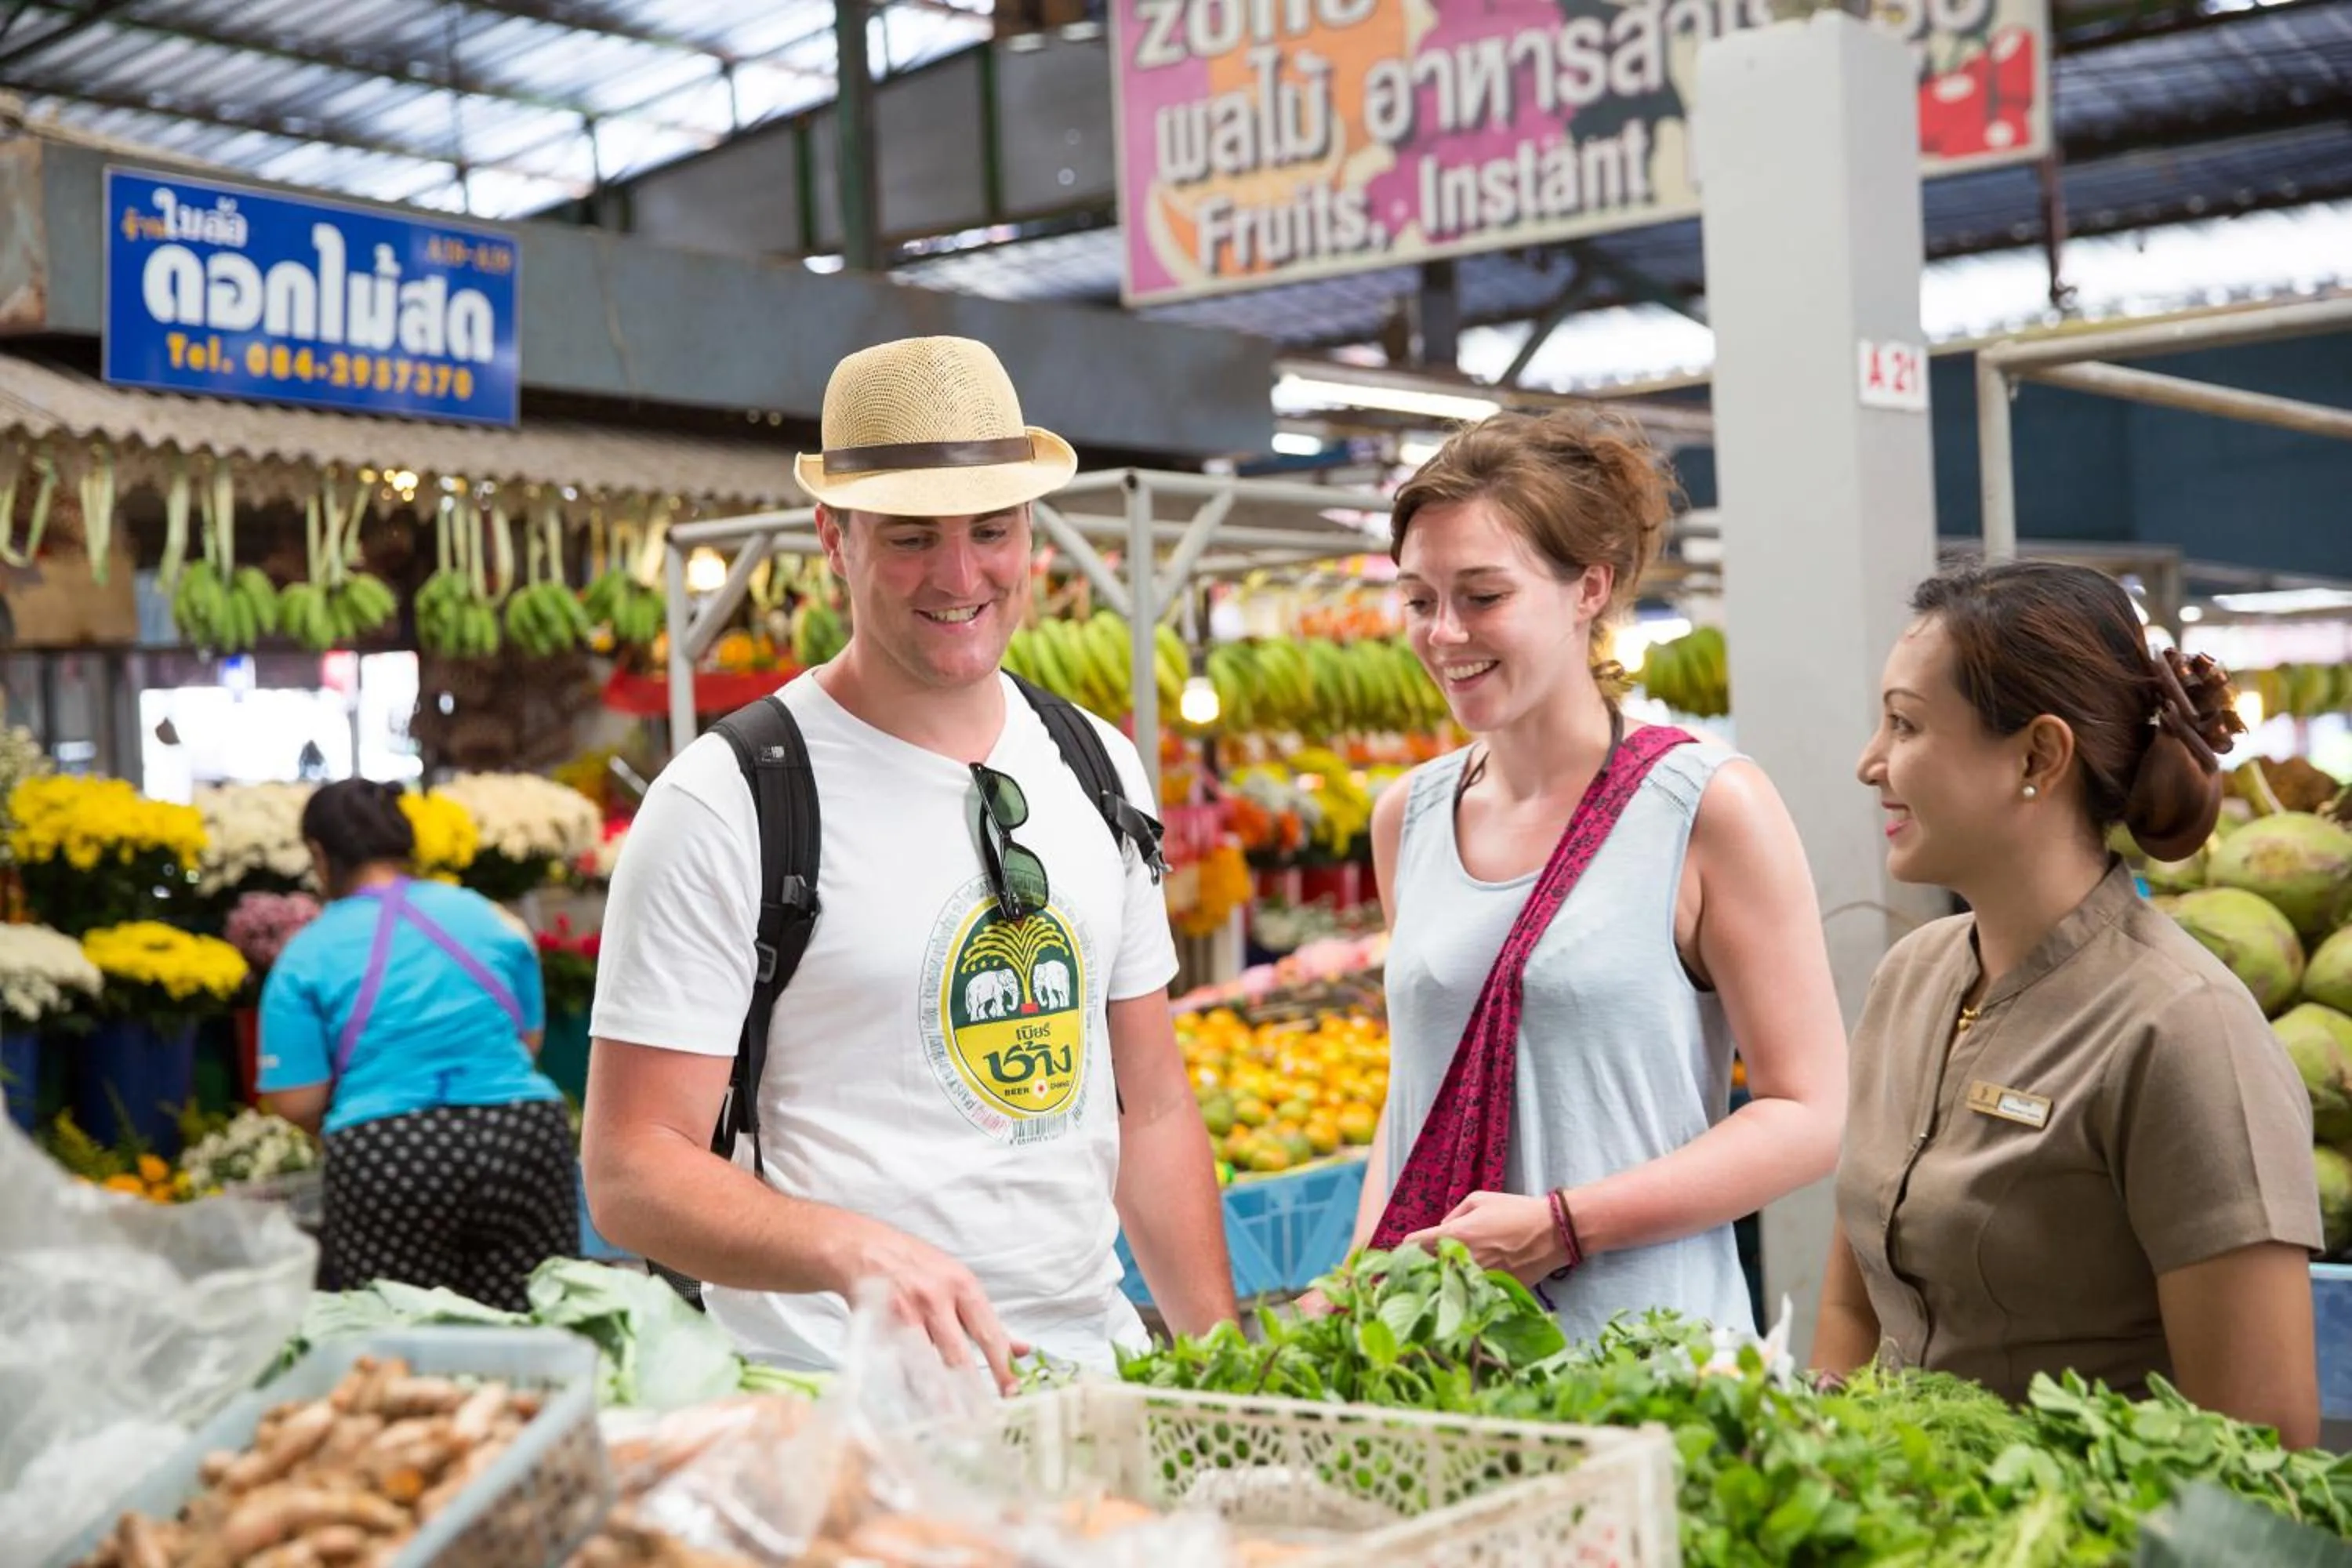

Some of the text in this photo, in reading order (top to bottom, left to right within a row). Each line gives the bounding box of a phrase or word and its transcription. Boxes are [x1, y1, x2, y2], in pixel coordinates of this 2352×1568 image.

[1420, 121, 1650, 234] Instant
[143, 222, 495, 364] ดอกไม้สด
[166, 332, 233, 375] Tel.
[1868, 347, 1919, 392] A 21
[1015, 1022, 1051, 1040] เบียร์
[982, 1040, 1073, 1083] ช้าง
[1004, 1087, 1029, 1097] BEER
